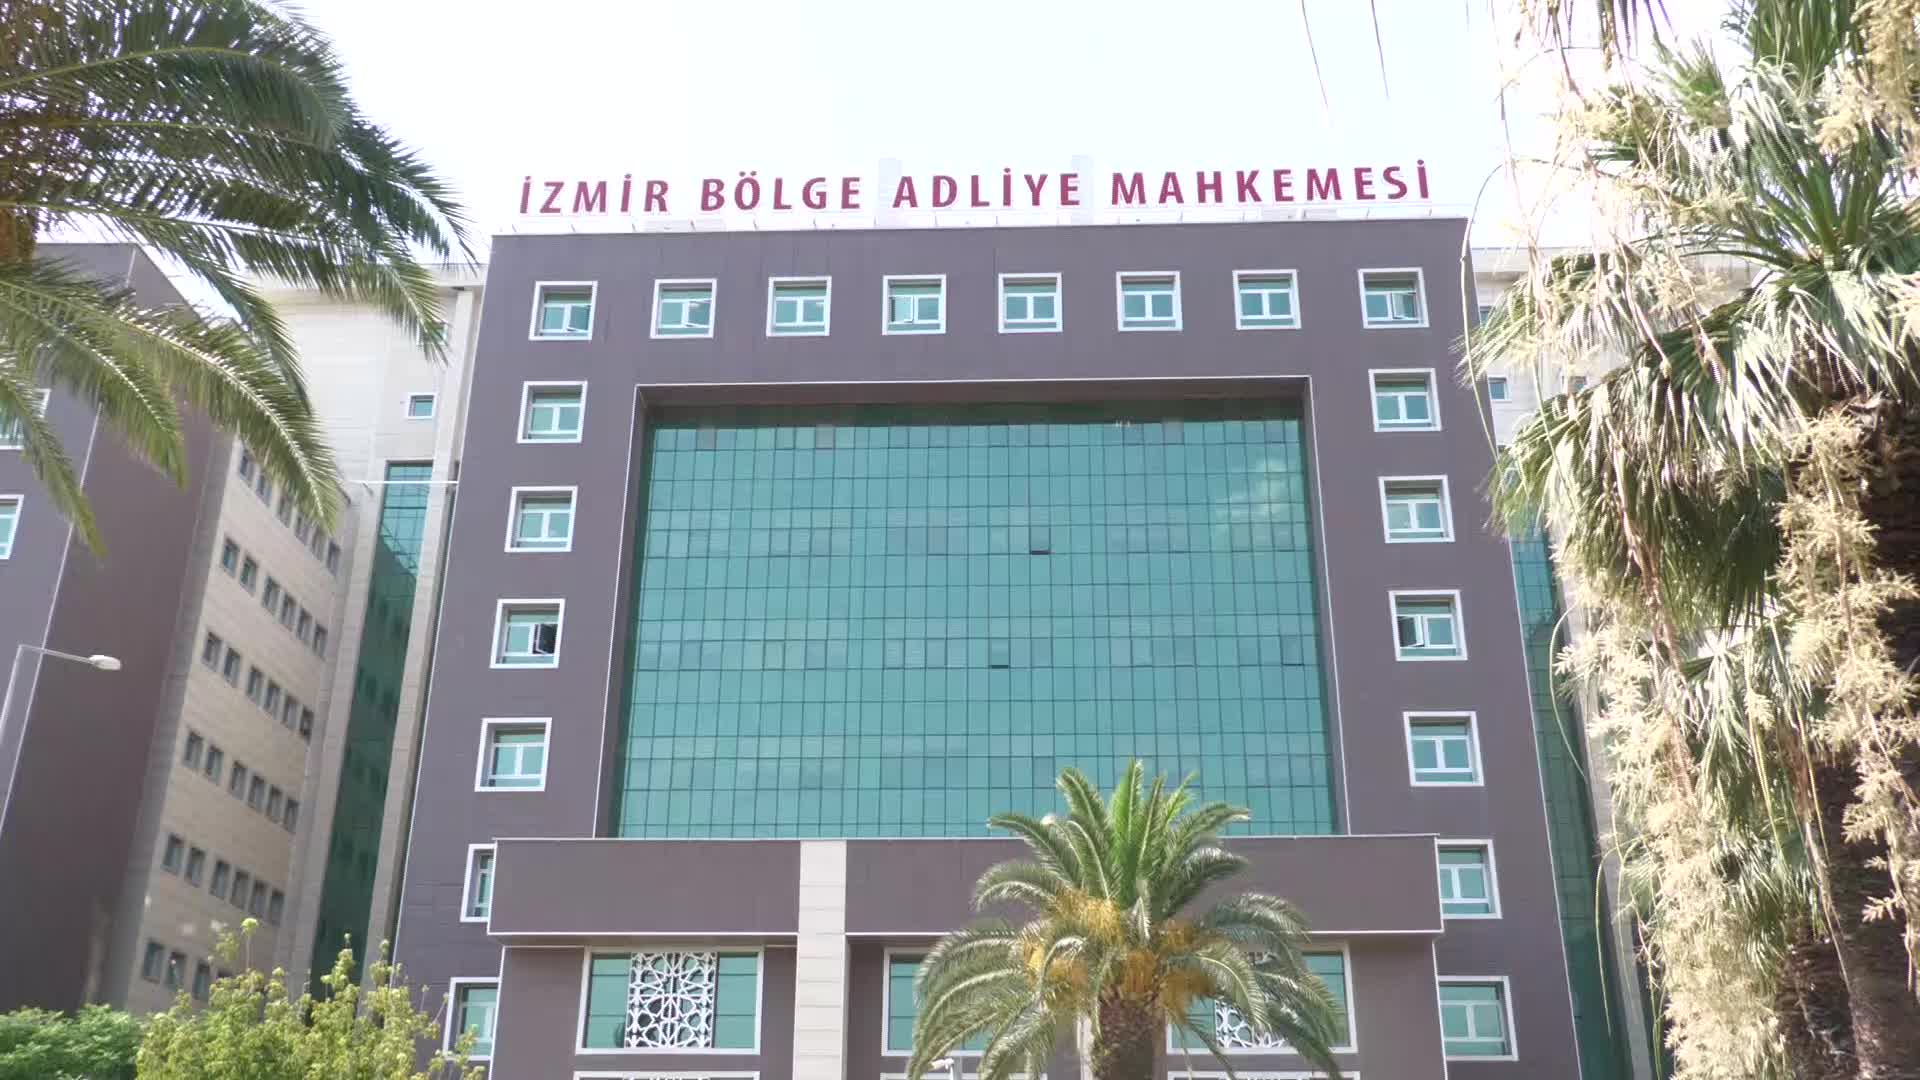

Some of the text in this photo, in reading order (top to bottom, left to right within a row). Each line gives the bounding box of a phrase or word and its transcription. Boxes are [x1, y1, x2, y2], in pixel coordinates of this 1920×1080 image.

[520, 159, 1430, 214] İZMİR BÖLGE ADLİYE MAHKEMESİ
